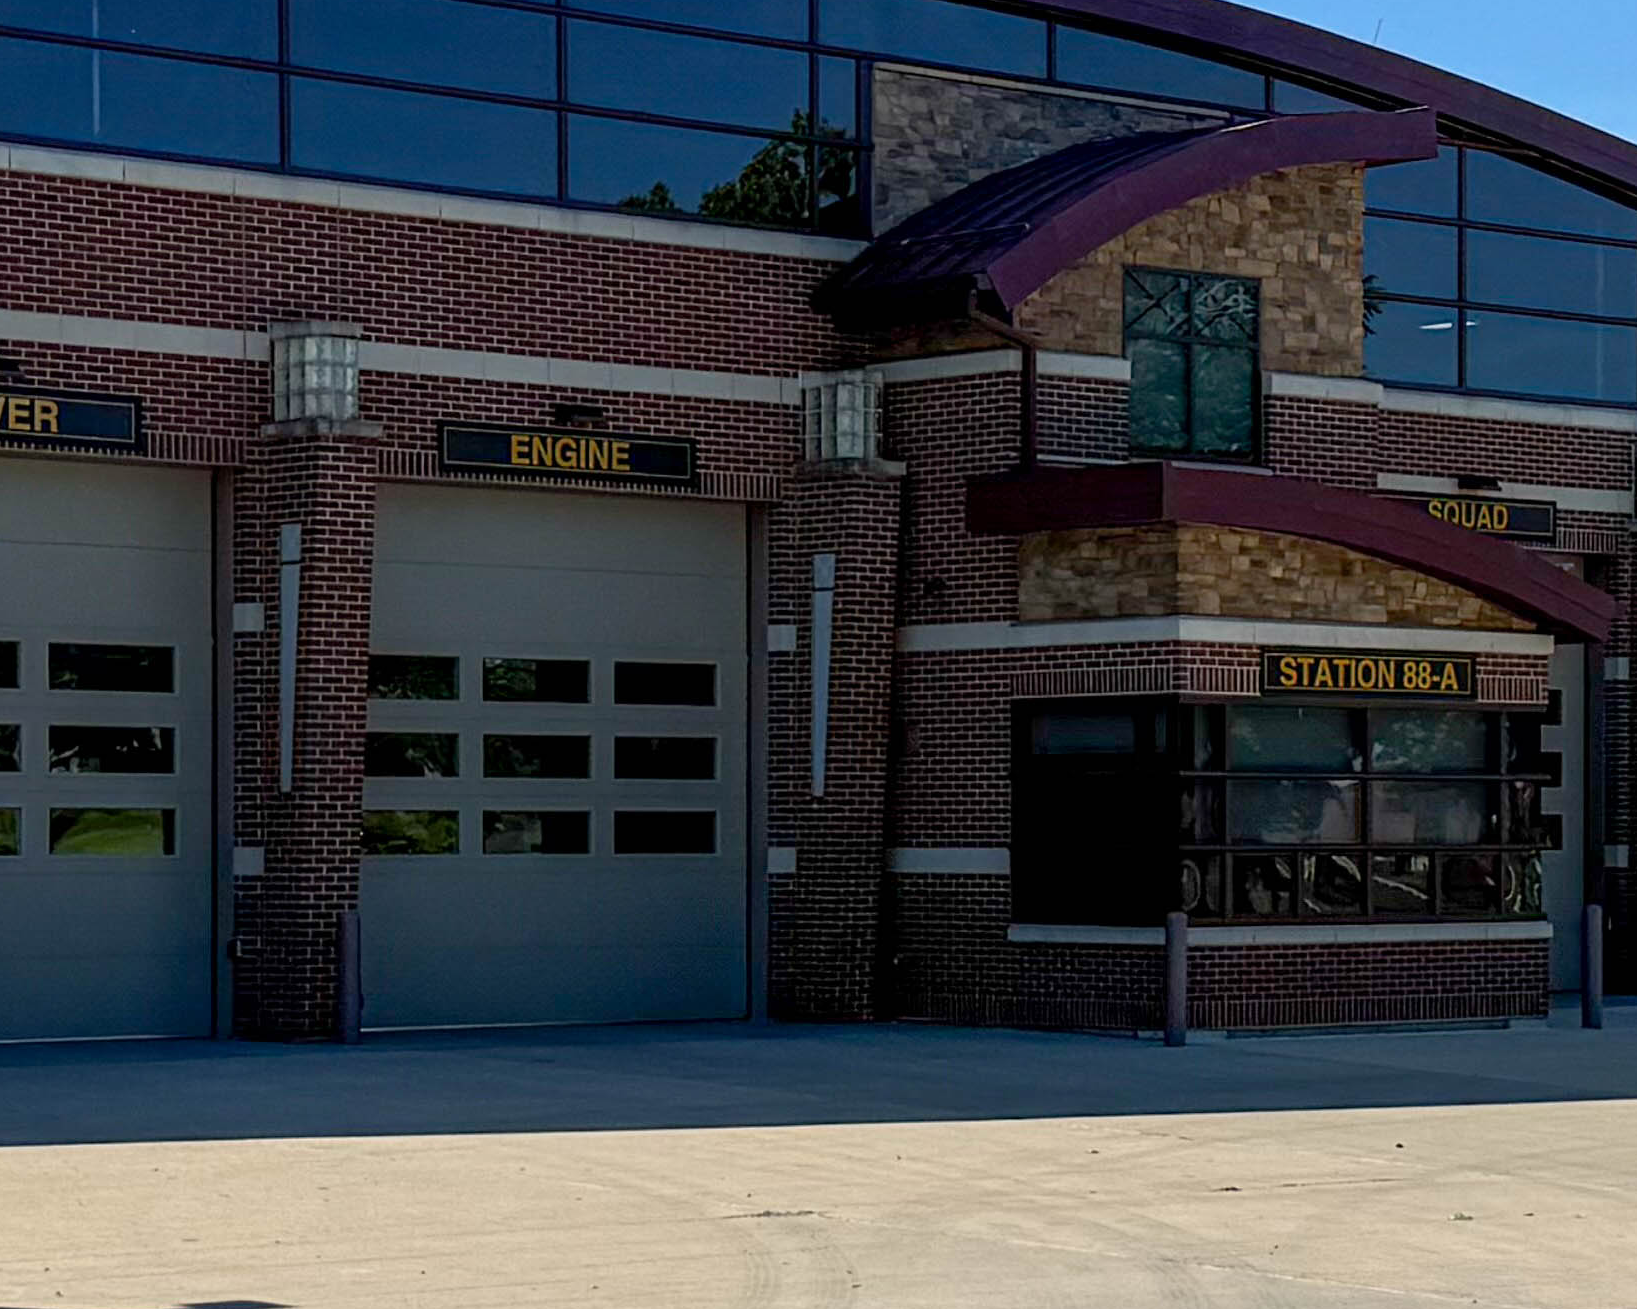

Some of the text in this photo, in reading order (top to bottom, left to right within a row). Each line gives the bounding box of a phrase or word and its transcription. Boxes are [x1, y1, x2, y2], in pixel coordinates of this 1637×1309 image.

[511, 435, 631, 471] ENGINE
[1428, 499, 1509, 530] SQUAD
[1279, 656, 1459, 691] STATION 88-A
